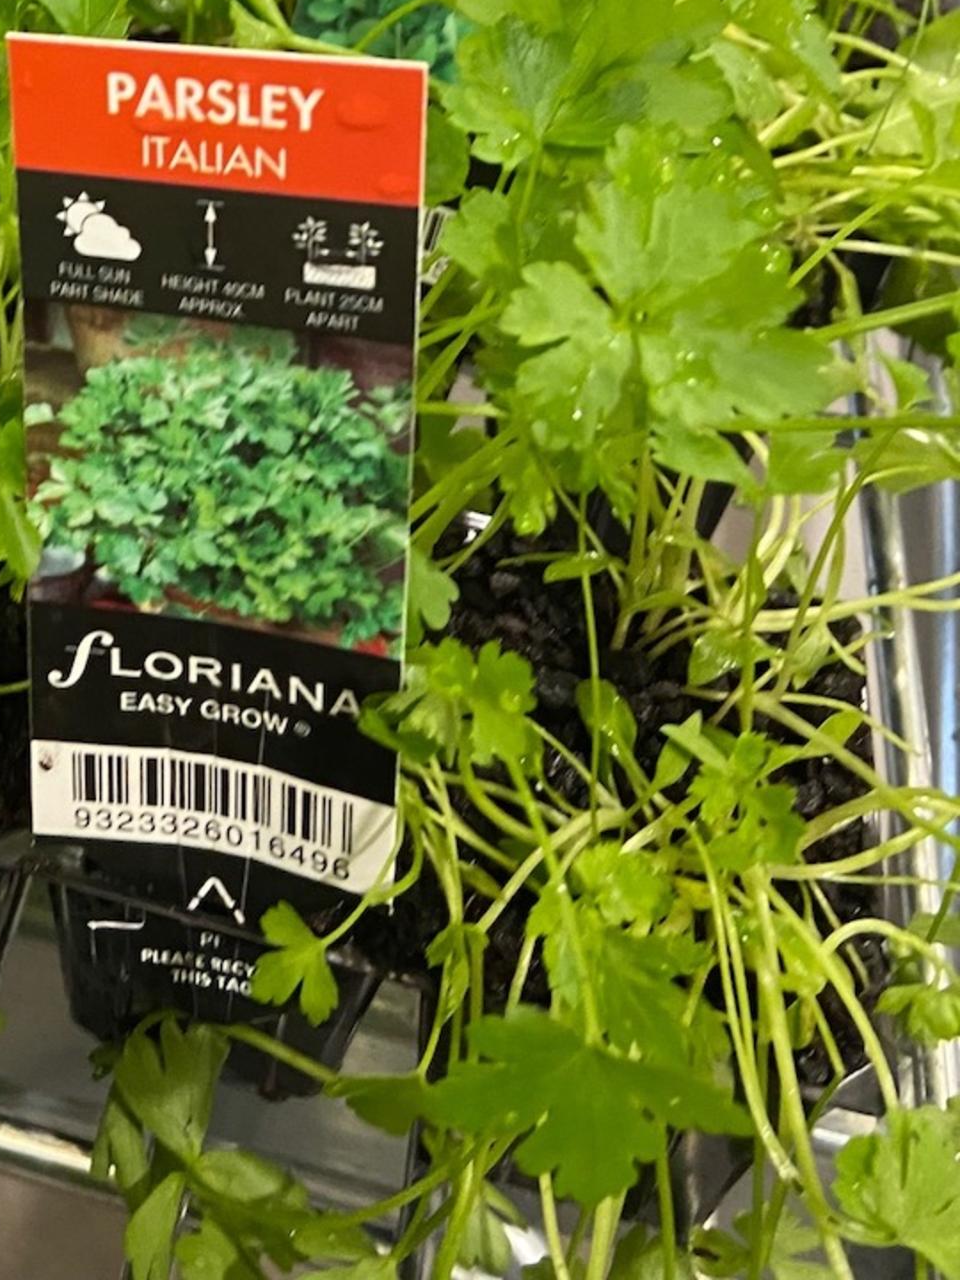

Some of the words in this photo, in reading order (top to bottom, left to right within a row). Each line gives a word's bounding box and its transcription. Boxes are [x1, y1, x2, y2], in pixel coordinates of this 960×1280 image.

[107, 71, 324, 131] PARSLEY
[142, 136, 286, 180] ITALIAN
[59, 261, 96, 280] FULL
[98, 266, 131, 284] SUN
[50, 280, 88, 299] PART
[93, 284, 144, 306] SHADE
[161, 274, 219, 295] HEIGHT
[180, 296, 244, 318] APPROX
[285, 288, 336, 307] PLANT
[306, 312, 359, 330] APART
[47, 630, 362, 718] FLORIANA
[120, 691, 192, 716] EASY
[200, 701, 288, 736] GROW
[74, 807, 351, 881] 9323326016496
[170, 969, 211, 988] THIS
[211, 957, 256, 979] RECY
